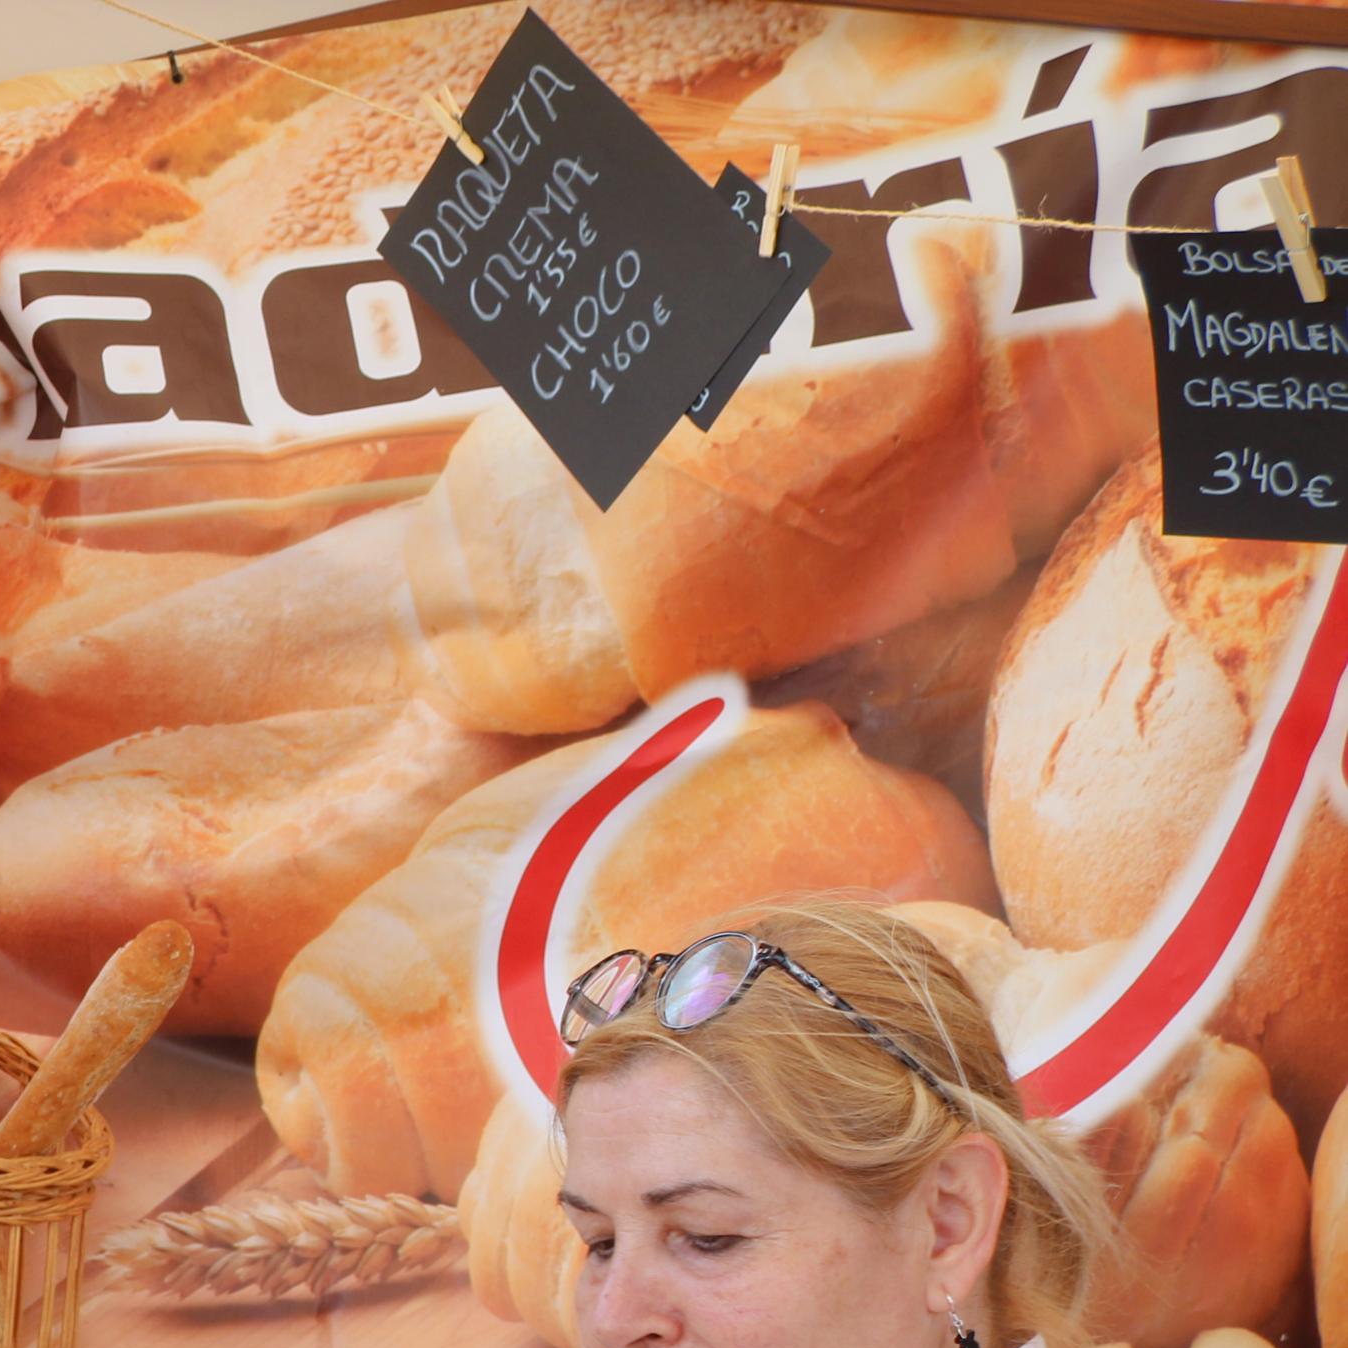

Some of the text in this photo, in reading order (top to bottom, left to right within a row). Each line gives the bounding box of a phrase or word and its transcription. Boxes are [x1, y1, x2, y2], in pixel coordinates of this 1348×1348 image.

[410, 63, 576, 284] RAQUETA
[531, 249, 641, 400] CHOCO
[1183, 377, 1348, 410] CASERAS
